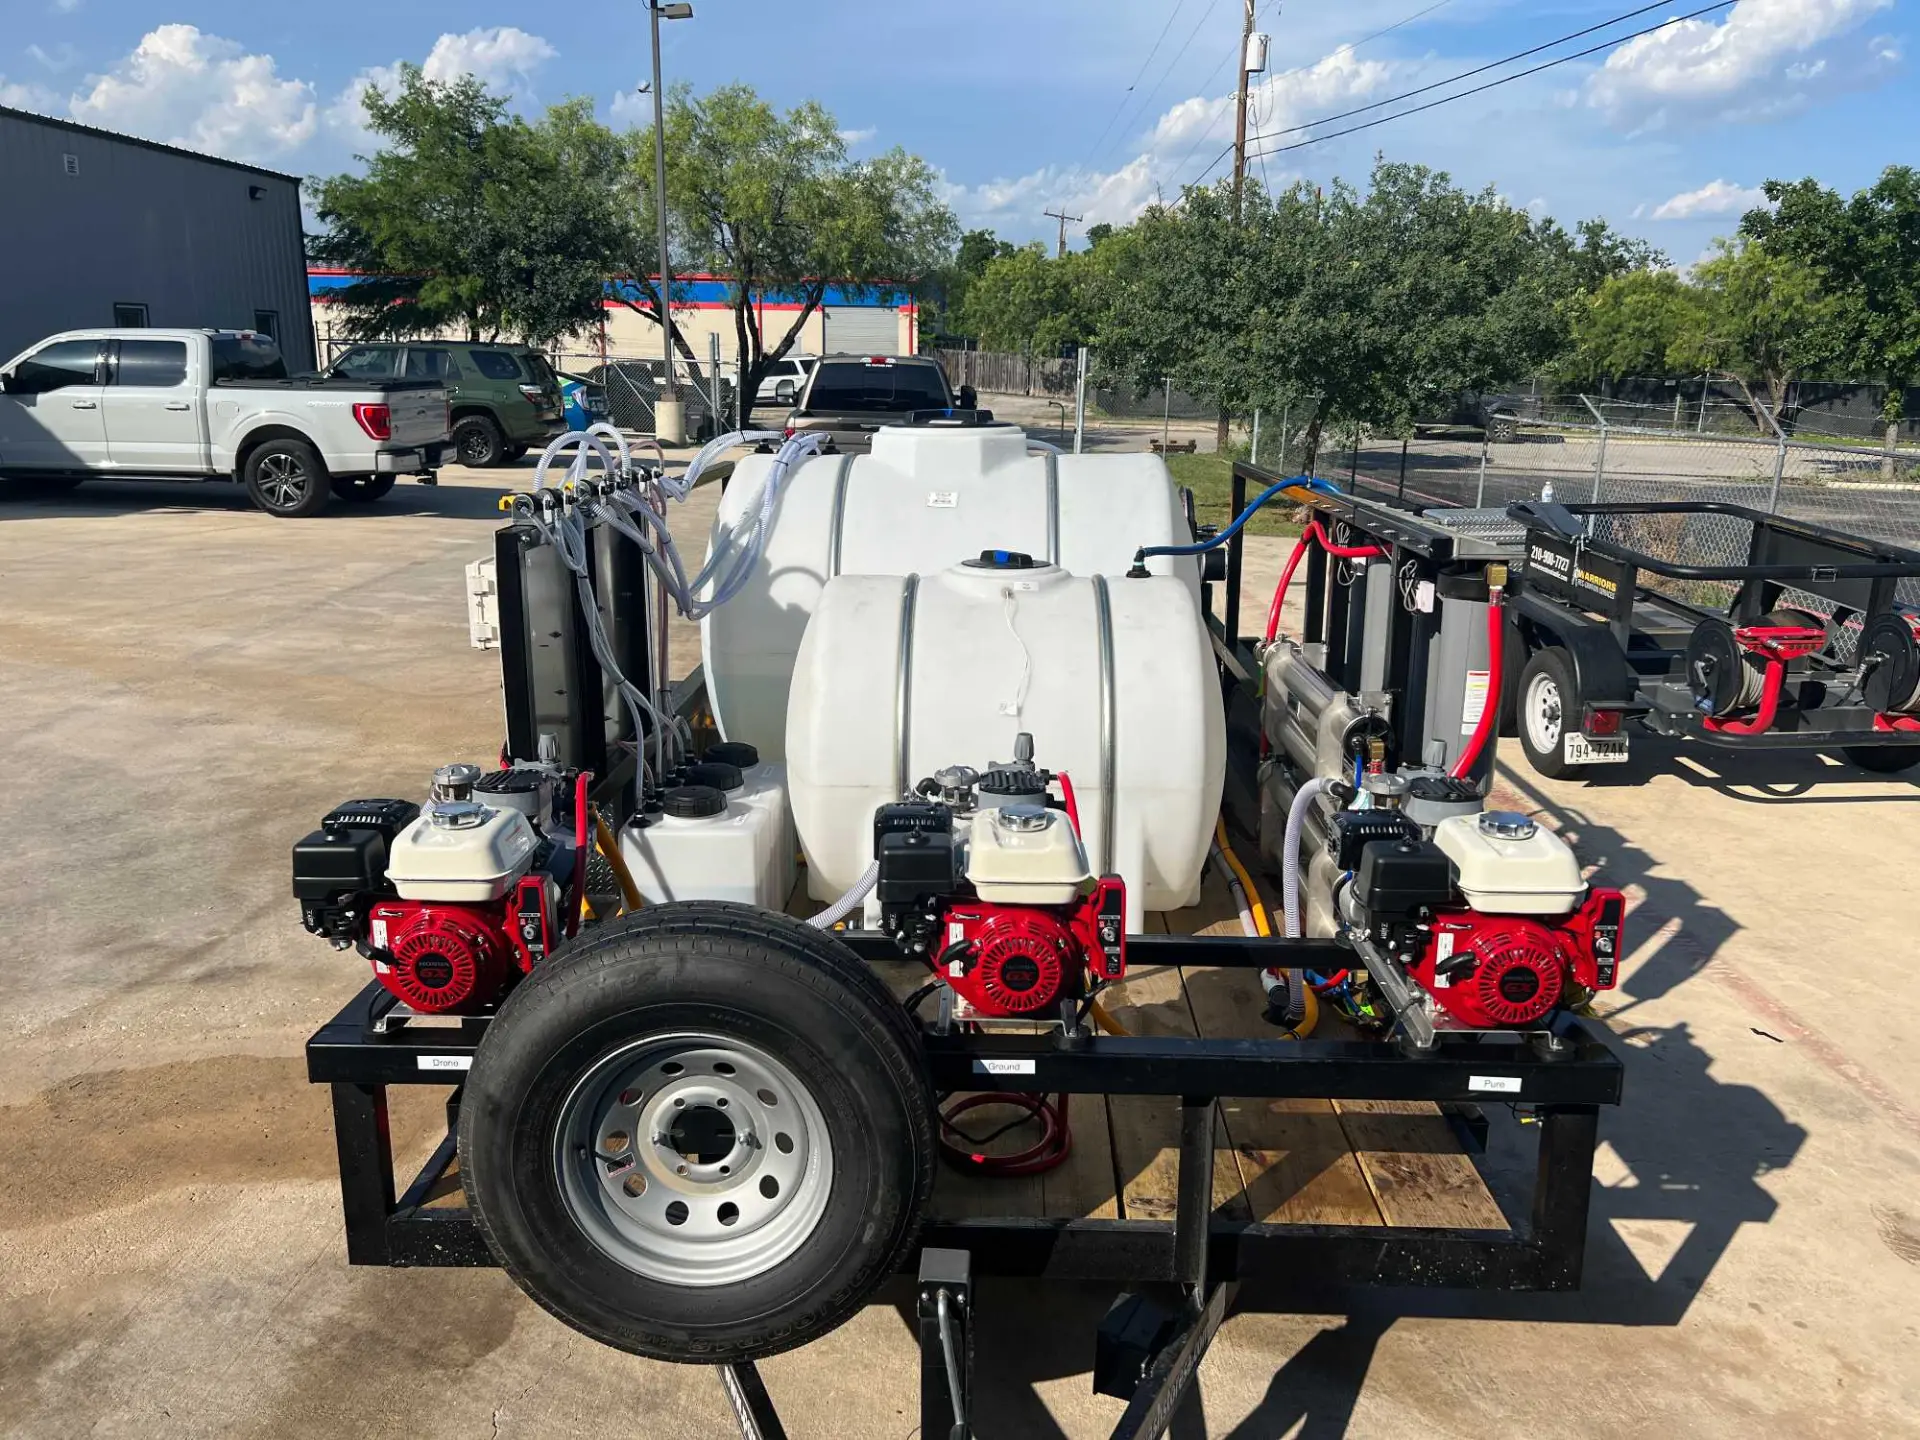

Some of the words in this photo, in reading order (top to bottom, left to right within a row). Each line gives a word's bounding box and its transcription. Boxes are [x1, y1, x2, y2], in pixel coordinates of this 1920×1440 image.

[1569, 744, 1589, 758] 794
[988, 1062, 1021, 1071] Ground
[1484, 1079, 1506, 1089] Pure
